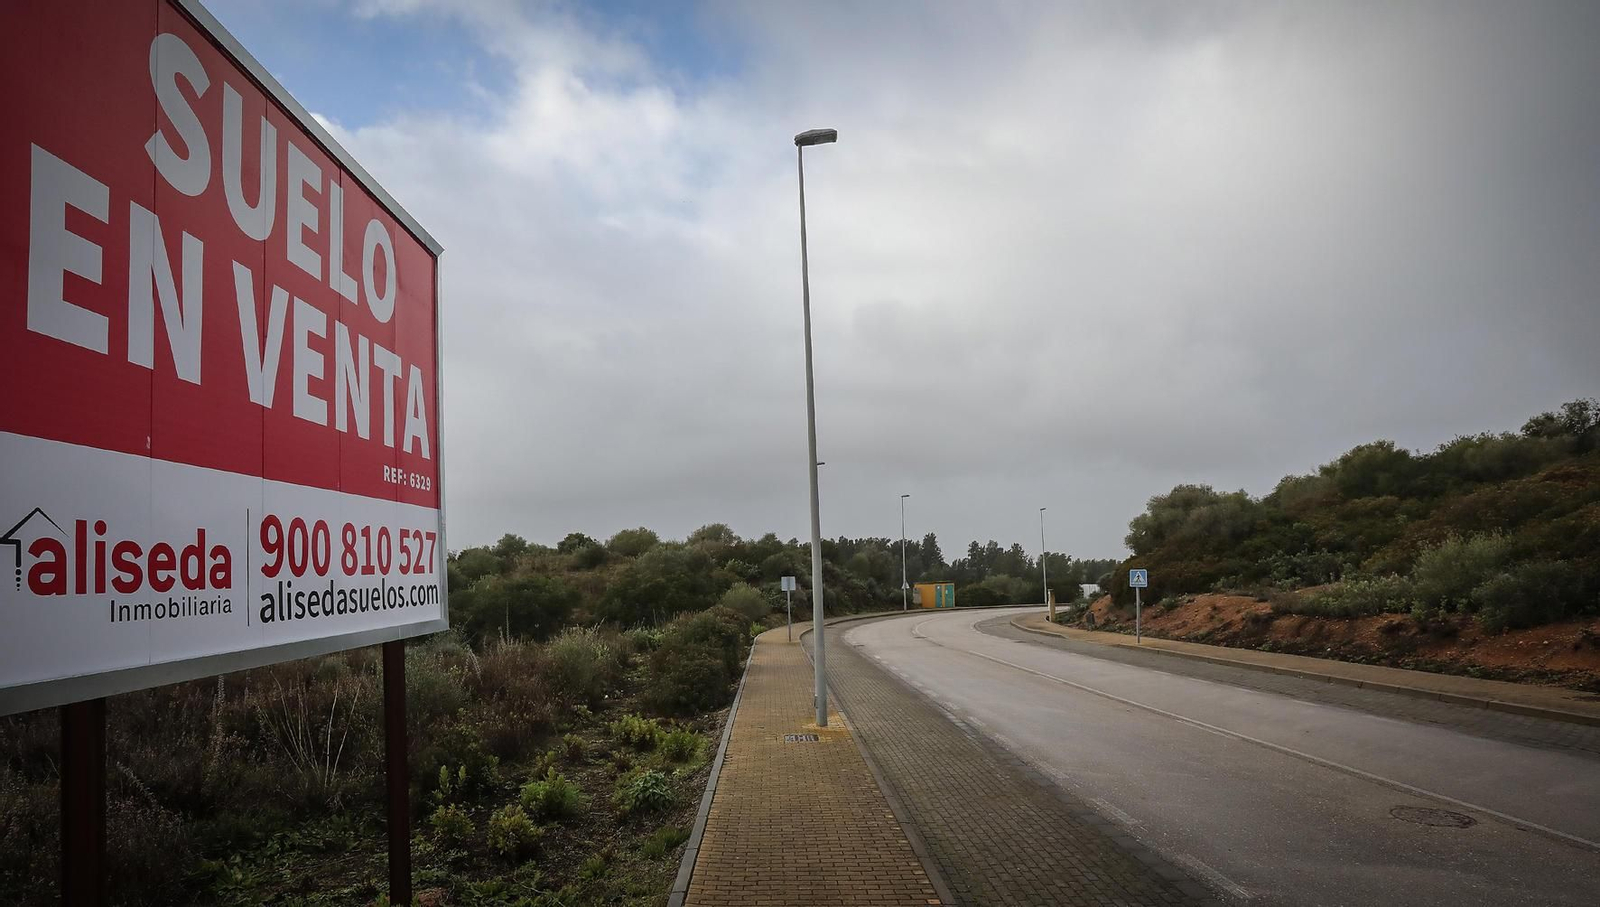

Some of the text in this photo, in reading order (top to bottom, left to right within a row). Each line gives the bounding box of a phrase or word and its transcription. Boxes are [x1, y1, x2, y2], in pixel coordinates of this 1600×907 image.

[144, 33, 396, 323] SUELO
[27, 142, 430, 459] EN VENTA
[383, 464, 431, 491] REF: 6329
[27, 519, 232, 596] aliseda
[260, 514, 437, 578] 900 810 527
[110, 595, 232, 622] Inmobiliaria
[260, 578, 439, 623] alisedasuelos.com
